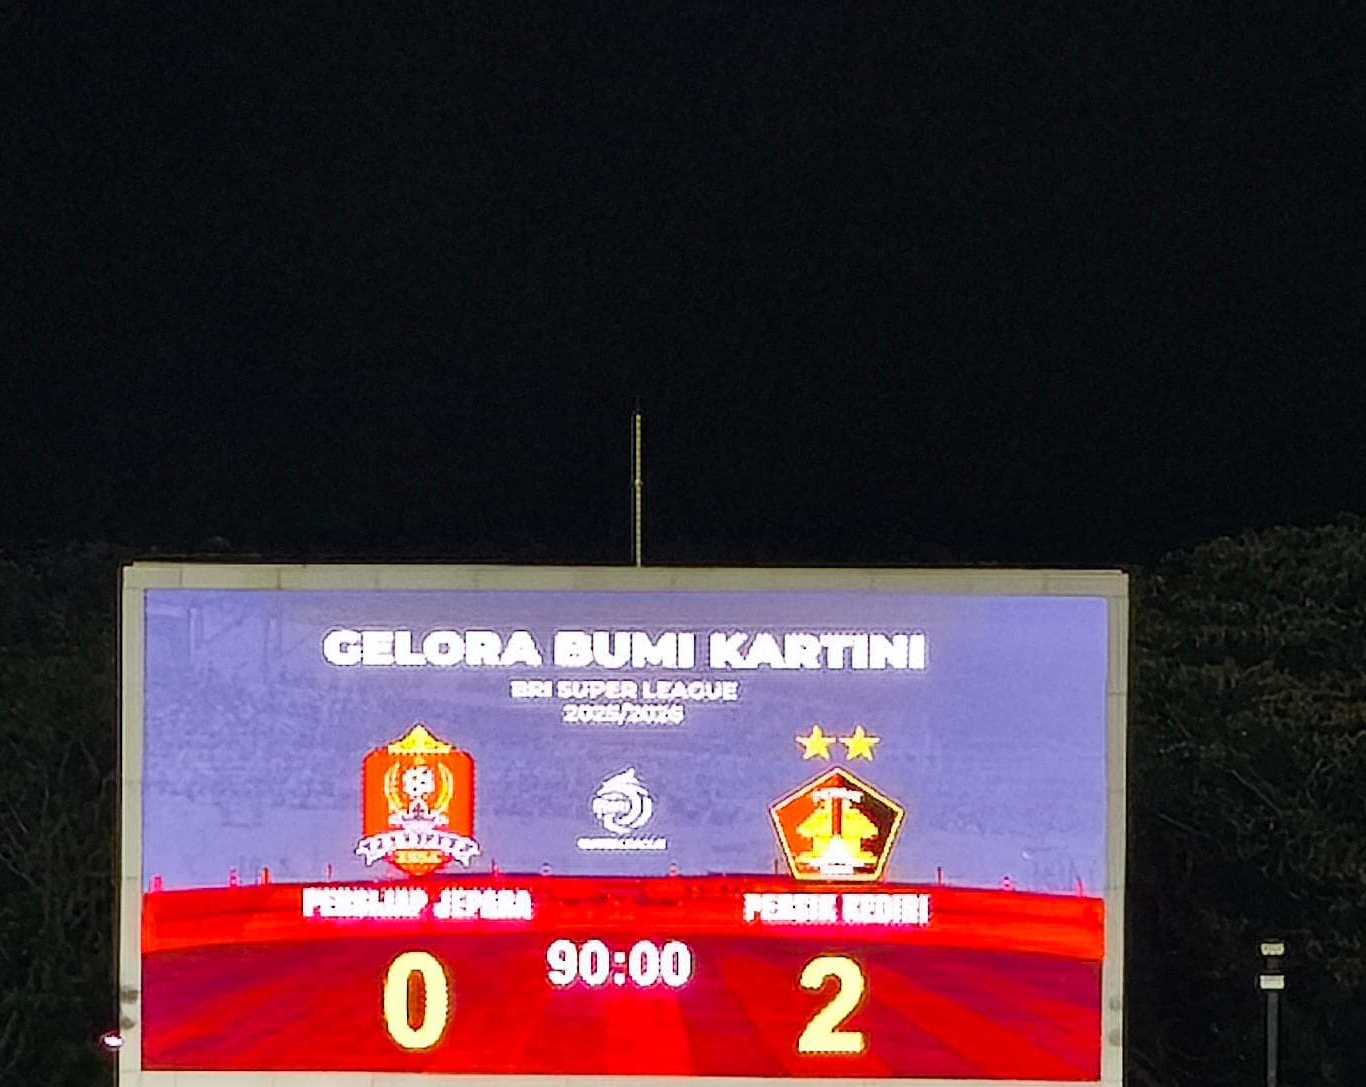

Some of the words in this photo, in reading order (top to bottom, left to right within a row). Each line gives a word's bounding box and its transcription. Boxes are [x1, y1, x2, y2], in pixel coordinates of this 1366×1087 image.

[322, 629, 542, 667] GELORA
[553, 630, 696, 669] BUMI
[708, 631, 926, 671] KARTINI
[510, 680, 553, 699] BRI
[557, 680, 638, 701] SUPER
[642, 681, 739, 702] LEAGUE
[561, 702, 685, 725] 2025/2026
[546, 939, 692, 987] 90:00
[383, 951, 449, 1049] 0
[798, 956, 865, 1053] 2
